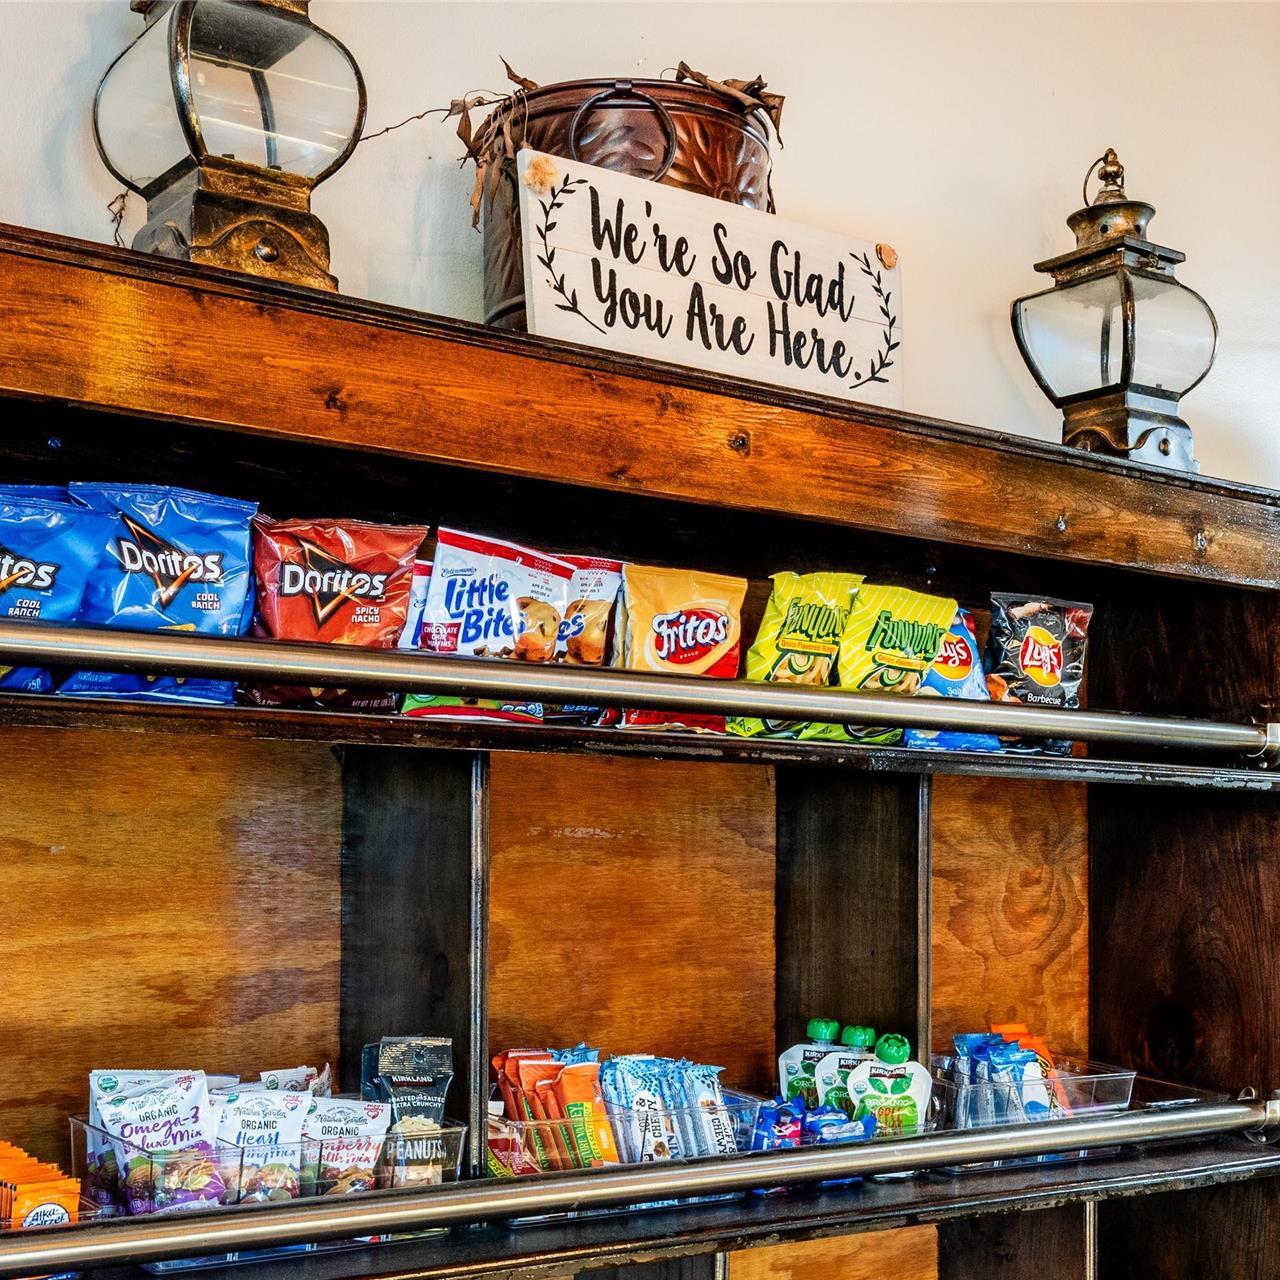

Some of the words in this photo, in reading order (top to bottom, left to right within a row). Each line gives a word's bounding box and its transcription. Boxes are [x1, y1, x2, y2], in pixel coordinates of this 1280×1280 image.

[589, 186, 696, 276] We're
[711, 222, 757, 290] So
[770, 240, 854, 322] Glad
[592, 257, 673, 339] You
[686, 282, 754, 355] Are
[121, 541, 222, 581] Doritos
[281, 563, 388, 597] Doritos
[16, 599, 41, 609] COOL
[191, 601, 221, 610] RANCH
[196, 593, 220, 602] COOL
[445, 574, 509, 619] Little
[8, 606, 40, 618] RANCH
[351, 614, 380, 623] NACHO
[355, 606, 380, 615] SPICY
[461, 608, 526, 643] Bites
[652, 609, 729, 660] Fritos
[866, 610, 947, 662] FUNYUNS
[934, 641, 968, 667] ay's
[1023, 636, 1060, 675] Lay's
[1028, 692, 1062, 705] Barbecue
[392, 1075, 433, 1083] KIRKLAND
[120, 1105, 200, 1139] Omega-3
[139, 1104, 179, 1122] ORGANIC
[241, 1119, 277, 1130] ORGANIC
[322, 1125, 359, 1136] ORGANIC
[170, 1129, 202, 1146] Mix
[235, 1131, 280, 1145] Heart
[712, 1117, 728, 1154] CHEWY
[386, 1139, 443, 1160] PEANUTS
[31, 1208, 60, 1222] Alka-
